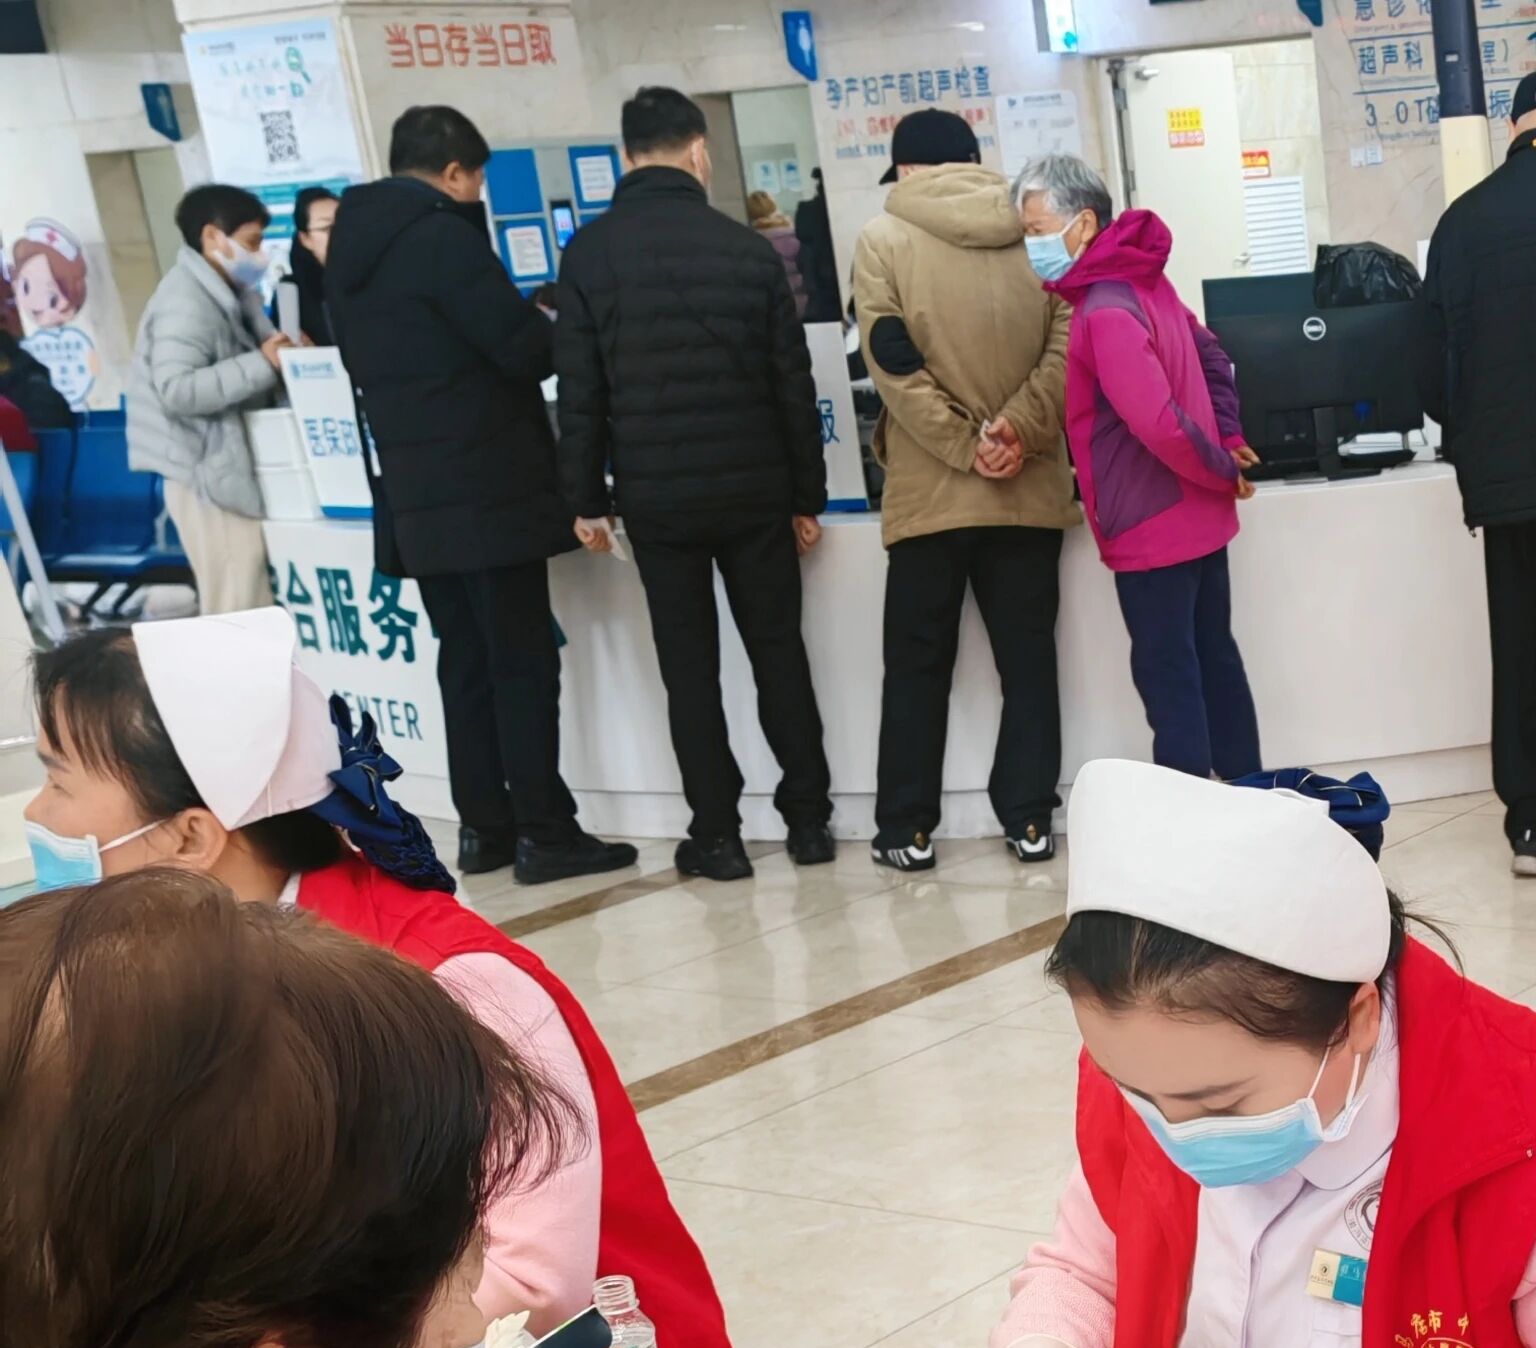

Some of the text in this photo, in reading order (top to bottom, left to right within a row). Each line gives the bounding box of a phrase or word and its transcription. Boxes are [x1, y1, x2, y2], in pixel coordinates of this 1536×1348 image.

[384, 23, 557, 68] 当日存当日取
[825, 64, 992, 109] 孕产妇产前超声检查
